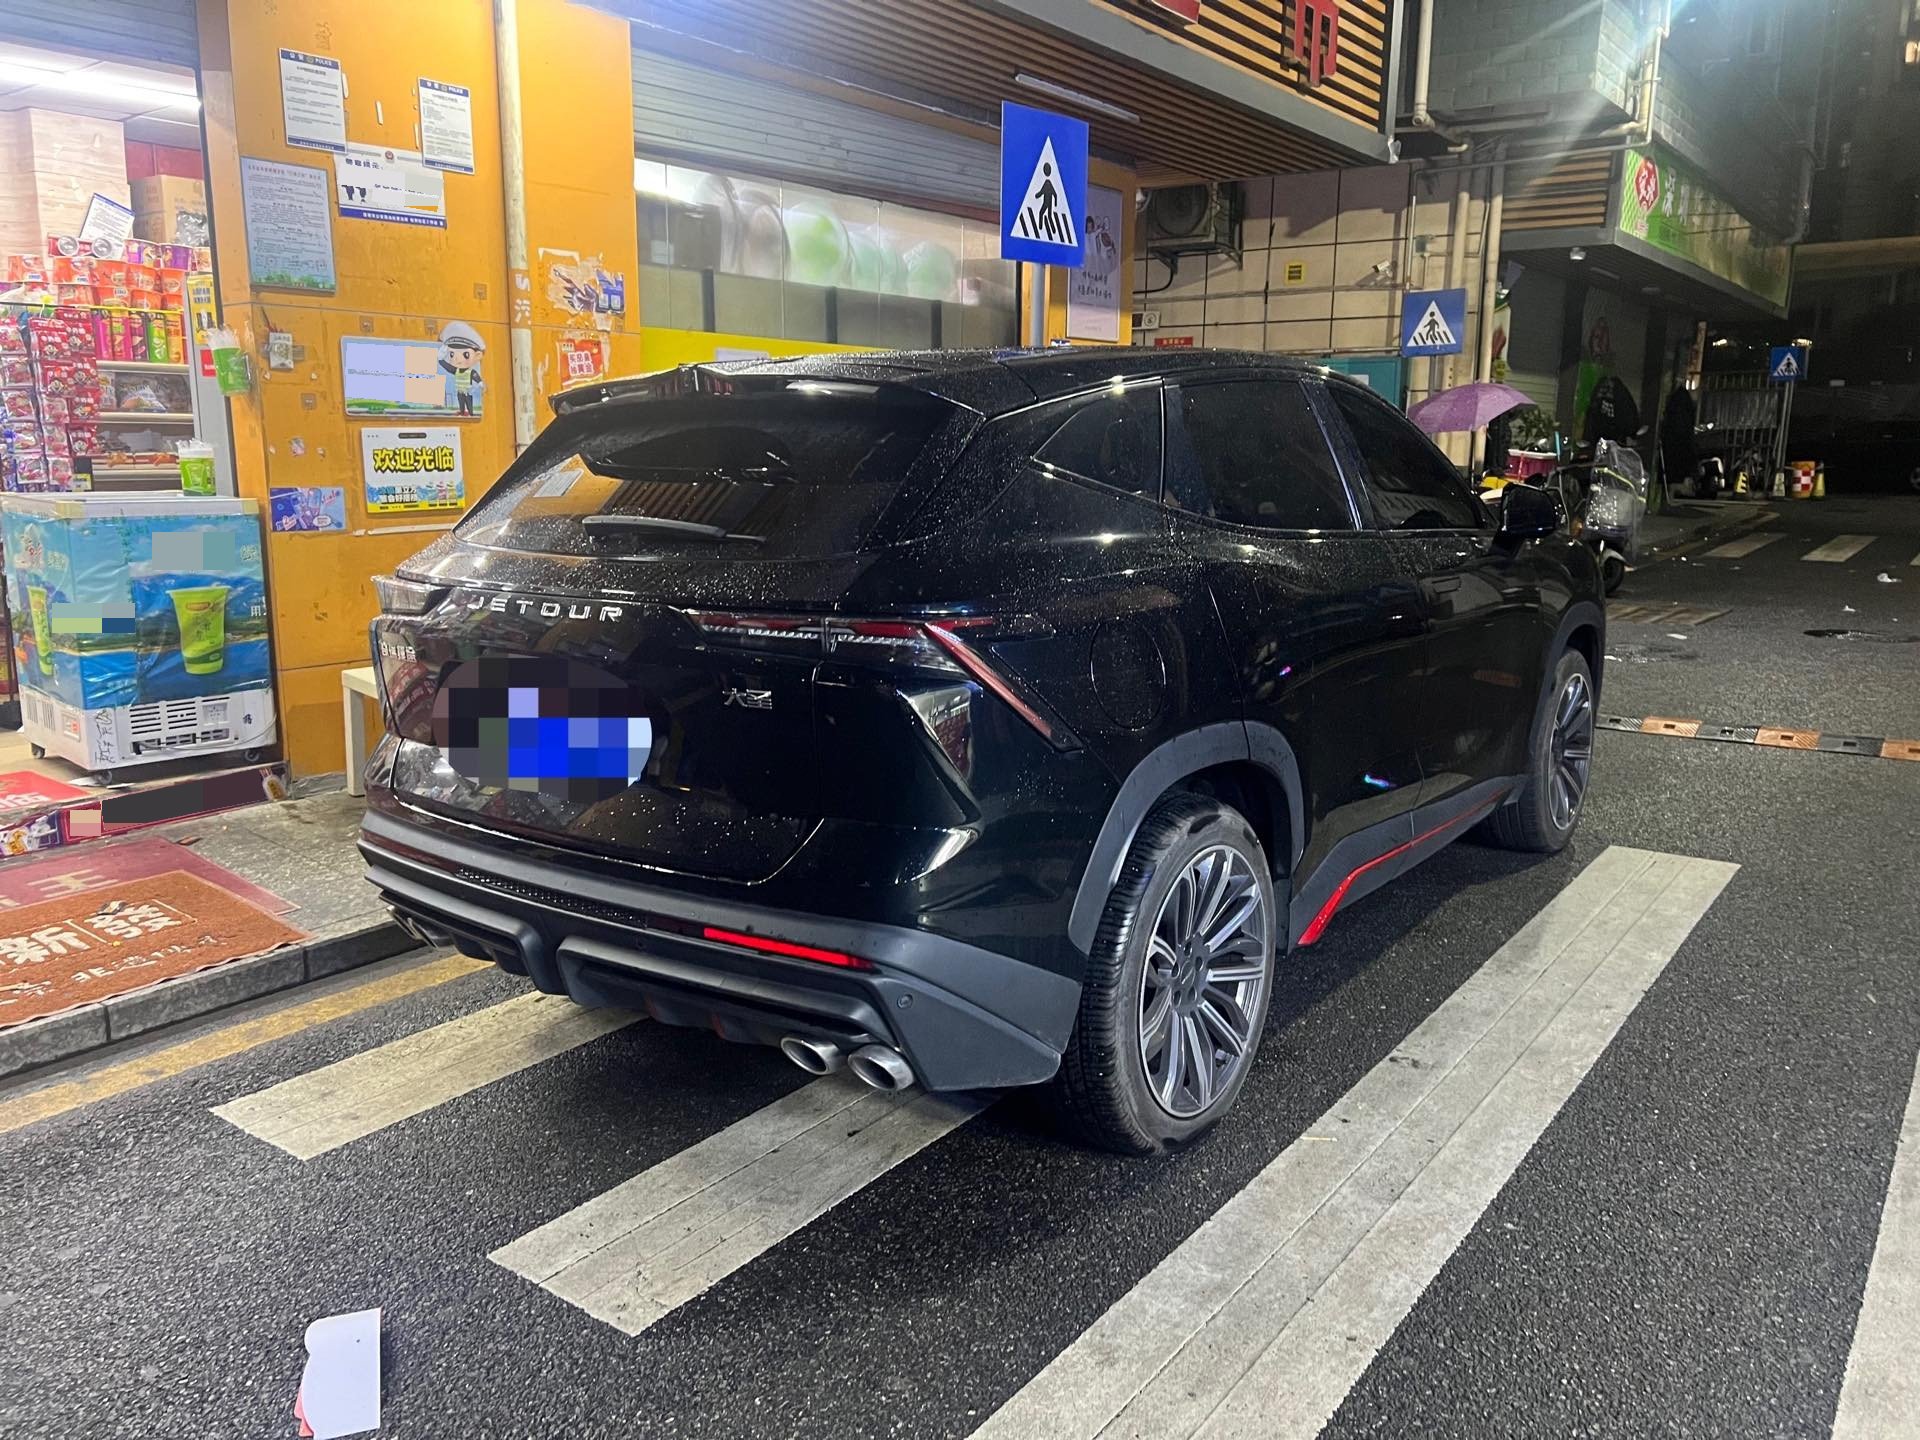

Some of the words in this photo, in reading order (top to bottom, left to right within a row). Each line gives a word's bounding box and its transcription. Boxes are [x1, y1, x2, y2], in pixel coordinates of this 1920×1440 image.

[372, 445, 455, 473] 欢迎光临
[466, 596, 624, 623] JETOUR
[722, 687, 773, 710] 大圣
